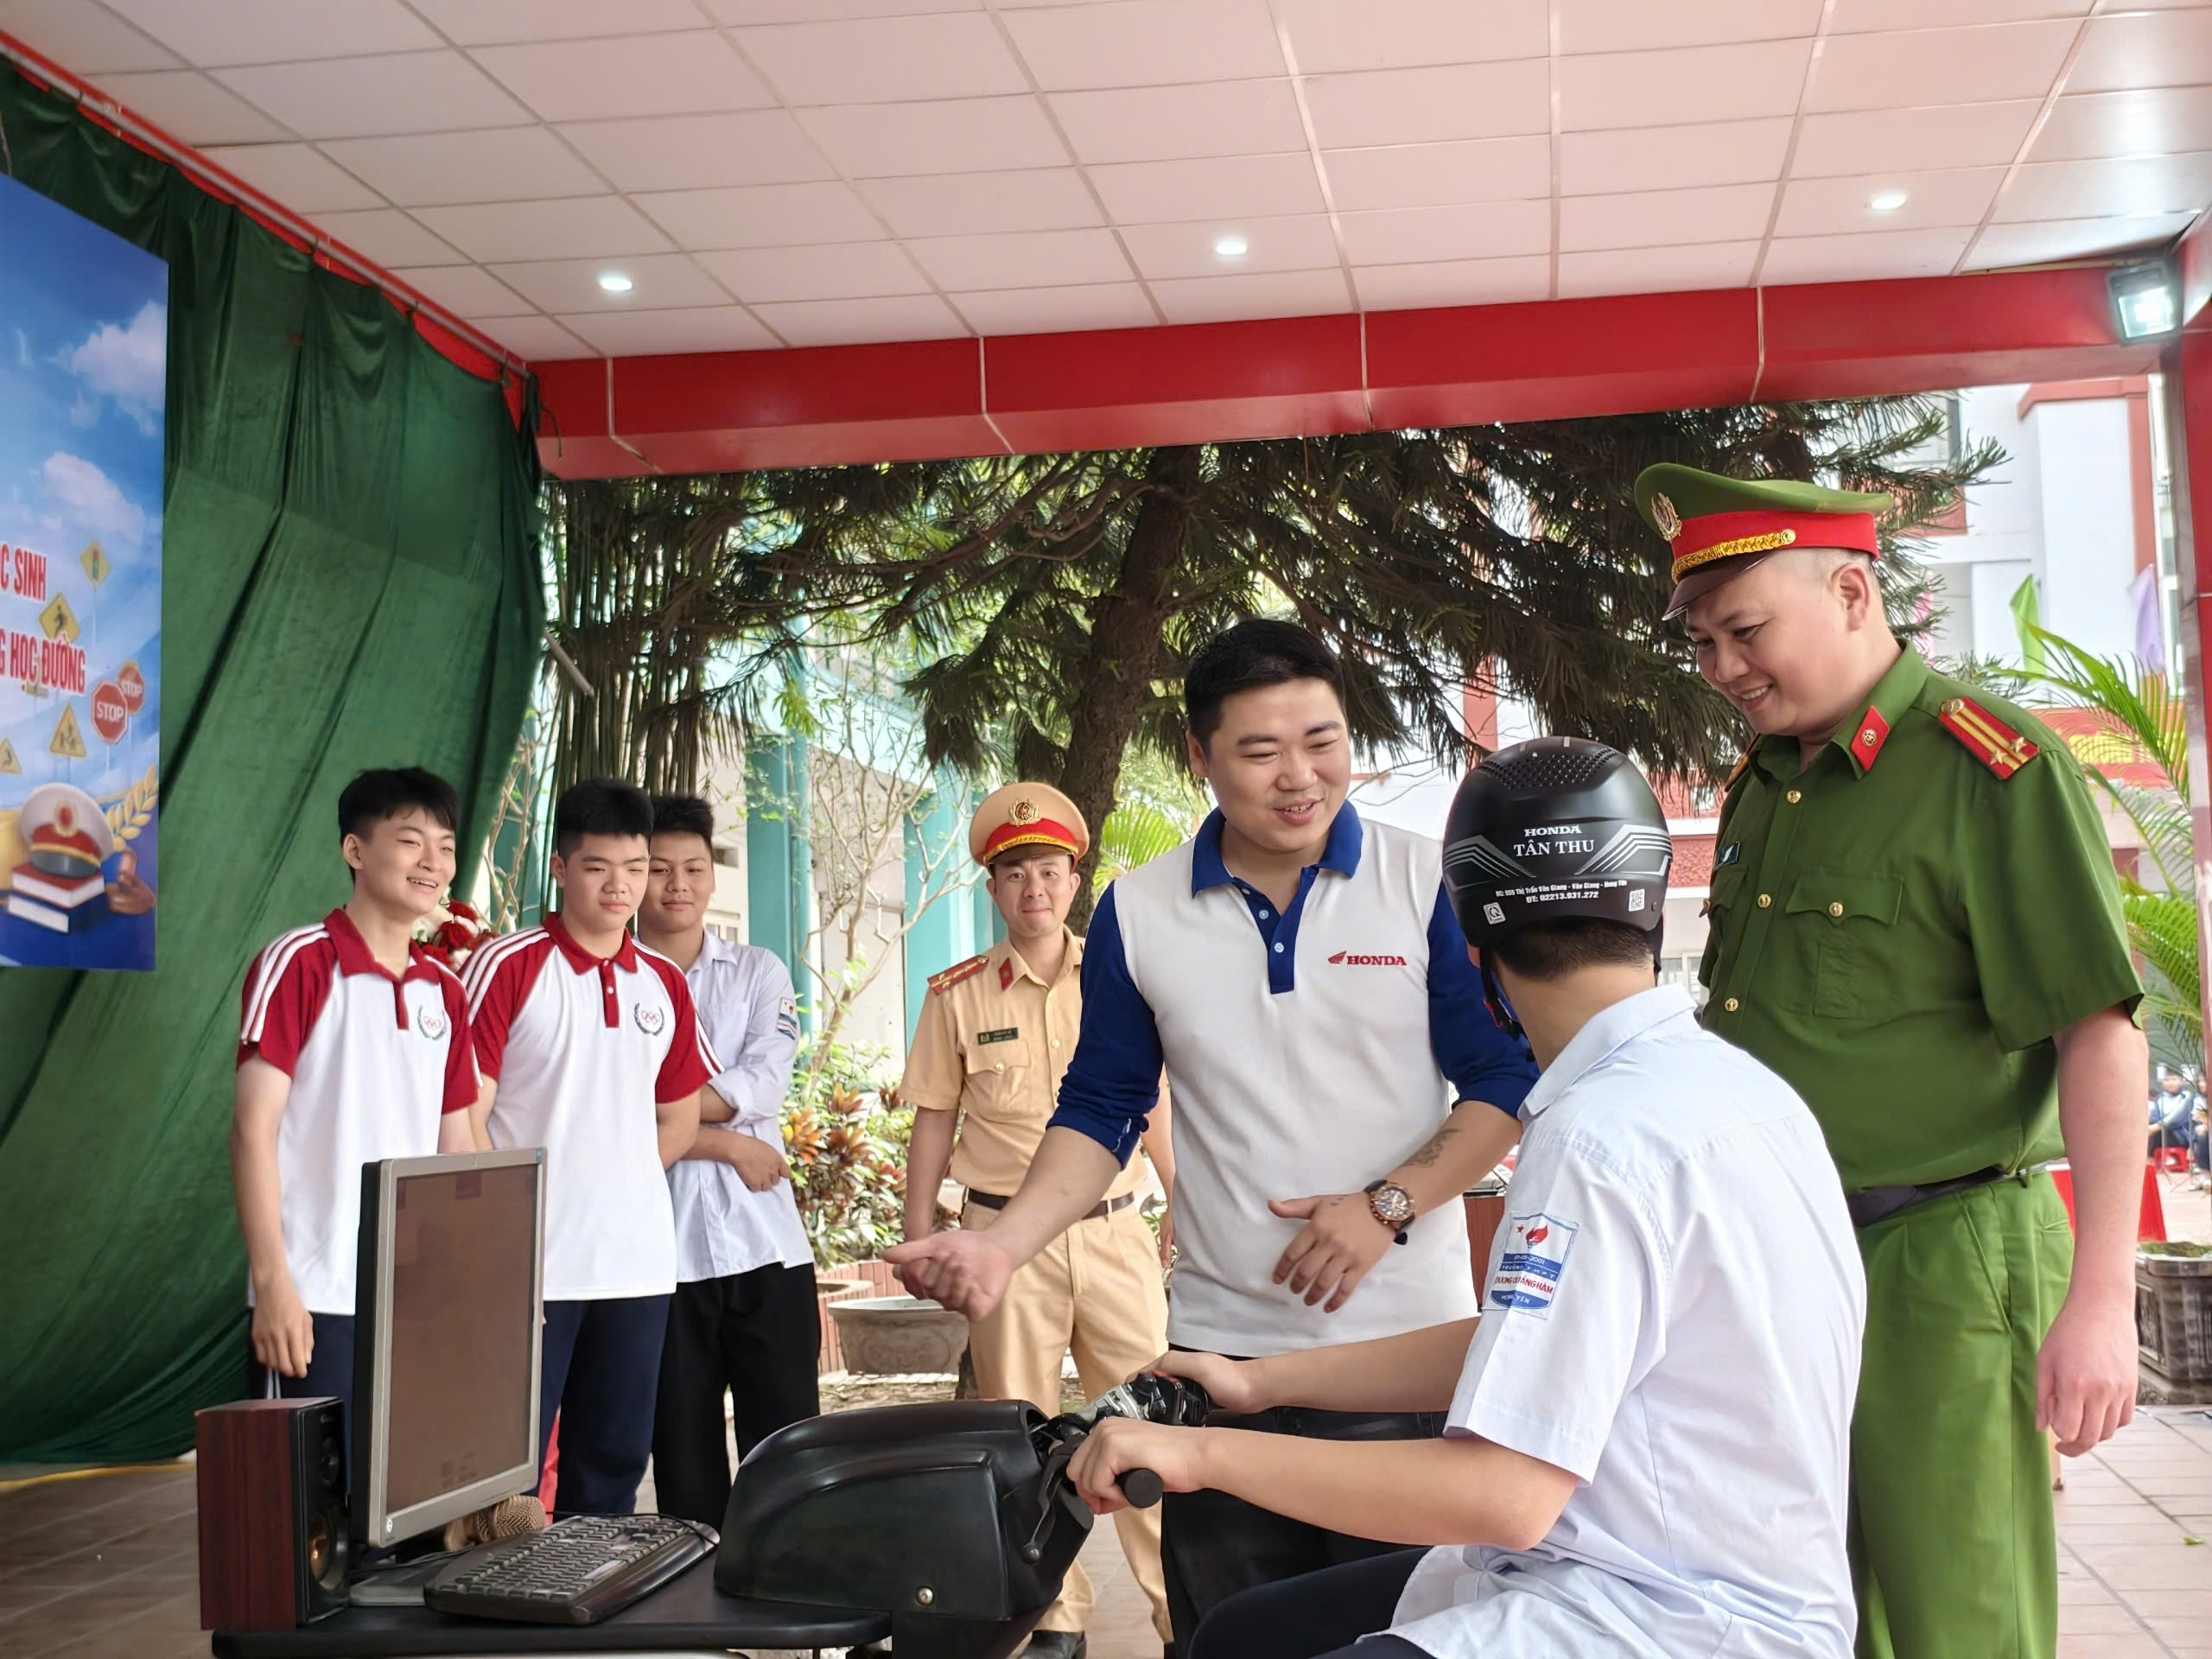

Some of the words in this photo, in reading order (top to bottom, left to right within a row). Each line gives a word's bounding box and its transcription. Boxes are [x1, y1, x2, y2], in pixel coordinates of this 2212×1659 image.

[14, 548, 47, 602] SINH
[10, 632, 37, 691] HỌC
[41, 632, 86, 694] ĐƯỜNG
[120, 681, 143, 699] STOP
[97, 701, 124, 723] STOP
[1524, 825, 1582, 836] HONDA
[1513, 839, 1551, 856] TÂN
[1555, 840, 1594, 854] THU
[1346, 955, 1407, 966] HONDA
